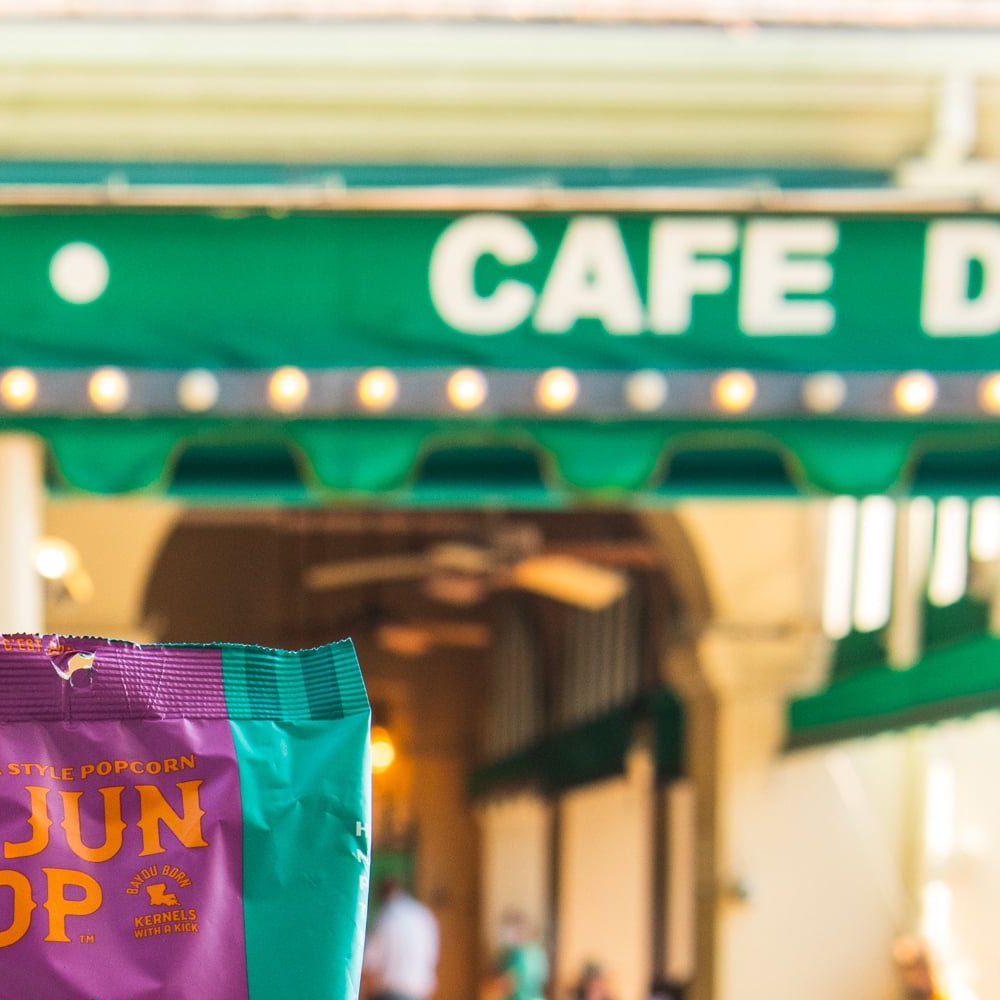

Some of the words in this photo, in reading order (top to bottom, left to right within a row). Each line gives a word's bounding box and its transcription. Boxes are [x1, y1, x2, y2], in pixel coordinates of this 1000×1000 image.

[429, 213, 839, 336] CAFE
[7, 762, 74, 781] STYLE
[80, 754, 196, 780] POPCORN
[125, 865, 158, 895] BAYOU
[162, 864, 193, 888] BORN
[134, 909, 198, 928] KERNELS
[134, 925, 161, 938] WITH
[164, 925, 171, 933] A
[174, 922, 199, 933] KICK
